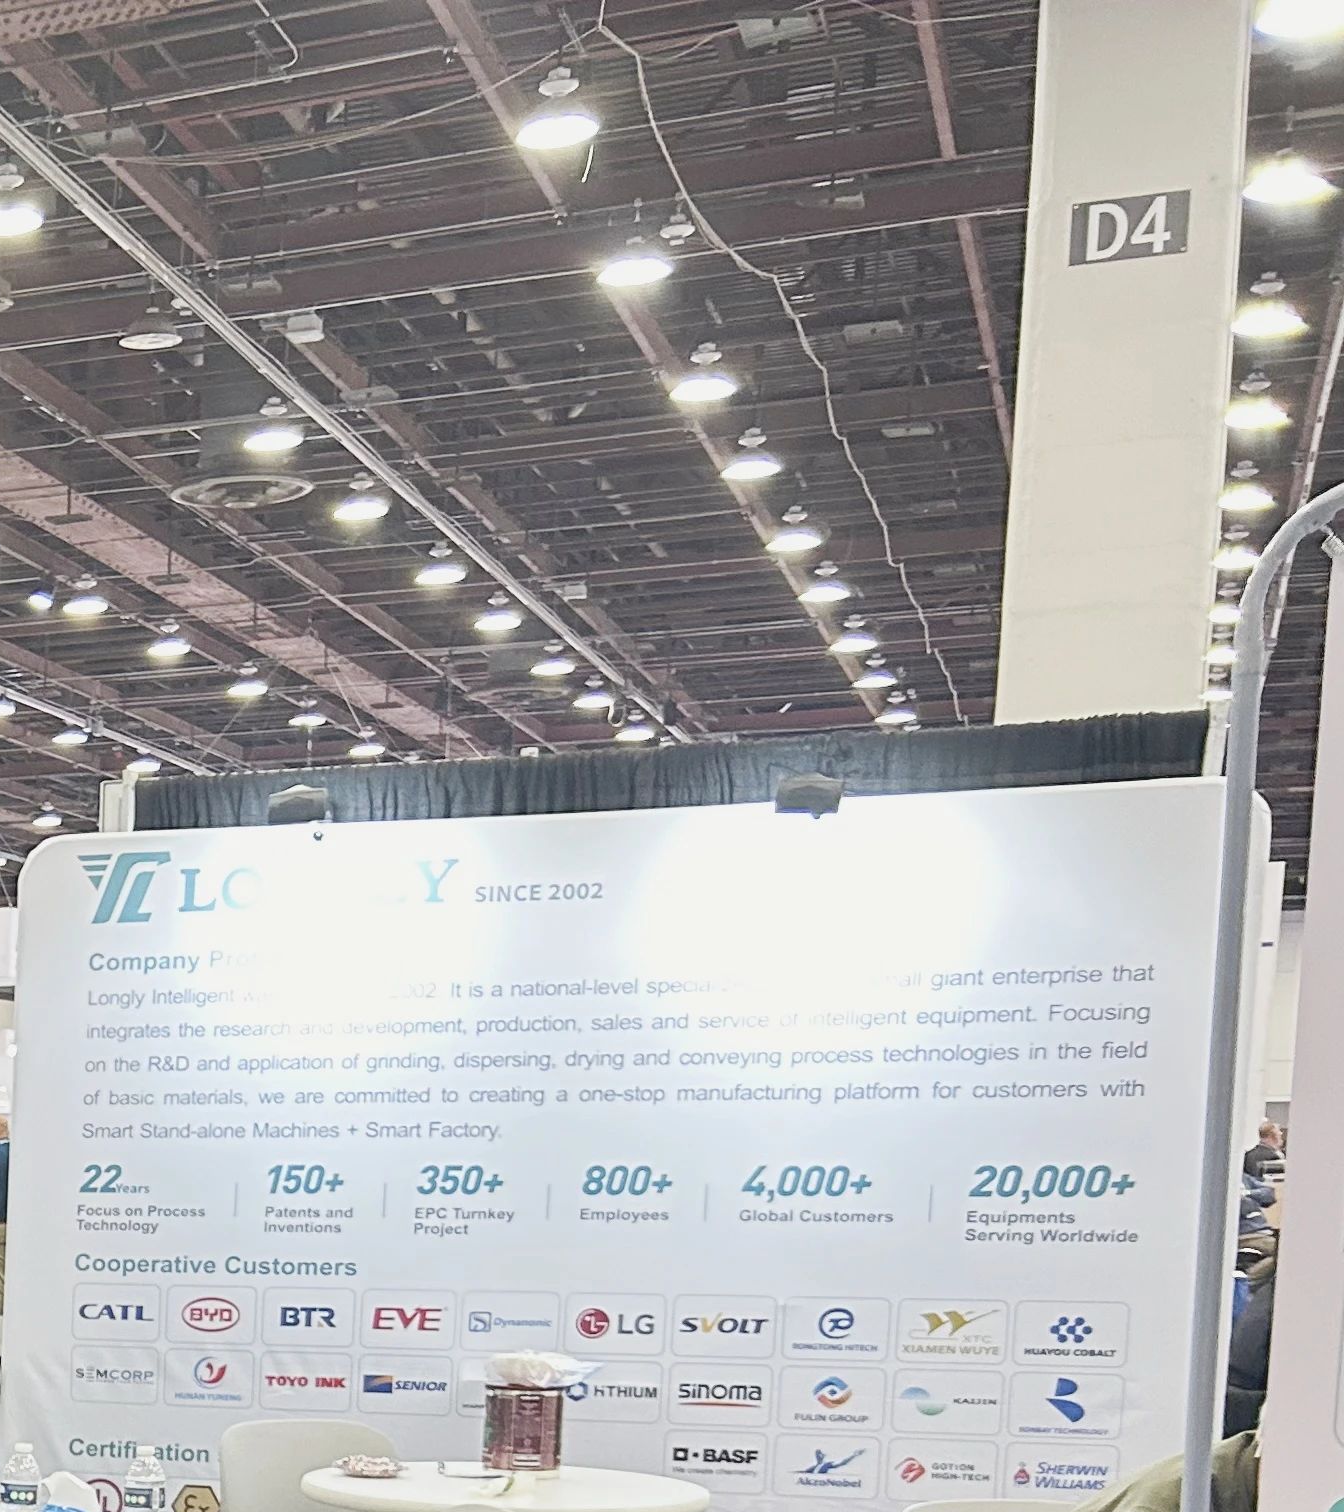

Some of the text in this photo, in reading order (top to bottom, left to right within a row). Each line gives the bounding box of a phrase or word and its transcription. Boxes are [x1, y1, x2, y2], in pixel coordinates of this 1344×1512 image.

[1085, 195, 1171, 262] D4
[474, 882, 604, 903] SINCE 2002
[88, 951, 200, 974] Company
[87, 964, 1155, 1010] Longly Intelligent national-level giant enterprise that
[85, 1003, 1152, 1042] integrates research production, sales service equipment. Focusing
[147, 1041, 1149, 1075] R&D application grinding, dispersing, drying conveying process technologies field
[108, 1079, 1146, 1107] basic materials, committed creating one-stop manufacturing platform customers with
[81, 1120, 503, 1143] Smart Stand-alone Machines Smart Factory.
[78, 1163, 151, 1195] 22 Years
[265, 1164, 345, 1195] 150+
[415, 1164, 505, 1196] 350+
[581, 1164, 673, 1197] 800+
[739, 1164, 873, 1203] 4,000+
[968, 1163, 1137, 1205] 20,000+
[76, 1204, 207, 1218] Focus on Process
[264, 1205, 355, 1220] Patents and
[413, 1206, 516, 1224] EPC Turnkey
[579, 1207, 670, 1225] Employees
[738, 1208, 895, 1224] Global Customers
[965, 1210, 1076, 1228] Equipments
[76, 1218, 160, 1235] Technology
[263, 1220, 343, 1235] Inventions
[412, 1221, 470, 1238] Project
[964, 1227, 1140, 1245] Serving Worldwide
[74, 1252, 358, 1278] Cooperative Customers
[78, 1303, 155, 1322] CATL
[189, 1307, 233, 1323] BYD
[279, 1305, 337, 1328] BTR
[371, 1306, 445, 1332] EVE
[678, 1311, 770, 1334] SVOLT
[617, 1313, 655, 1335] LG
[901, 1344, 1000, 1356] XIAMEN WUYE
[75, 1365, 154, 1382] SEMCORP
[265, 1374, 346, 1389] TOYO INK
[394, 1378, 448, 1393] SENIOR
[68, 1437, 210, 1464] Certifiation
[702, 1447, 759, 1465] BASF
[1037, 1460, 1110, 1478] SHERWIN
[796, 1476, 862, 1489] AkzoNobel
[1033, 1474, 1107, 1492] WILLIAMS
